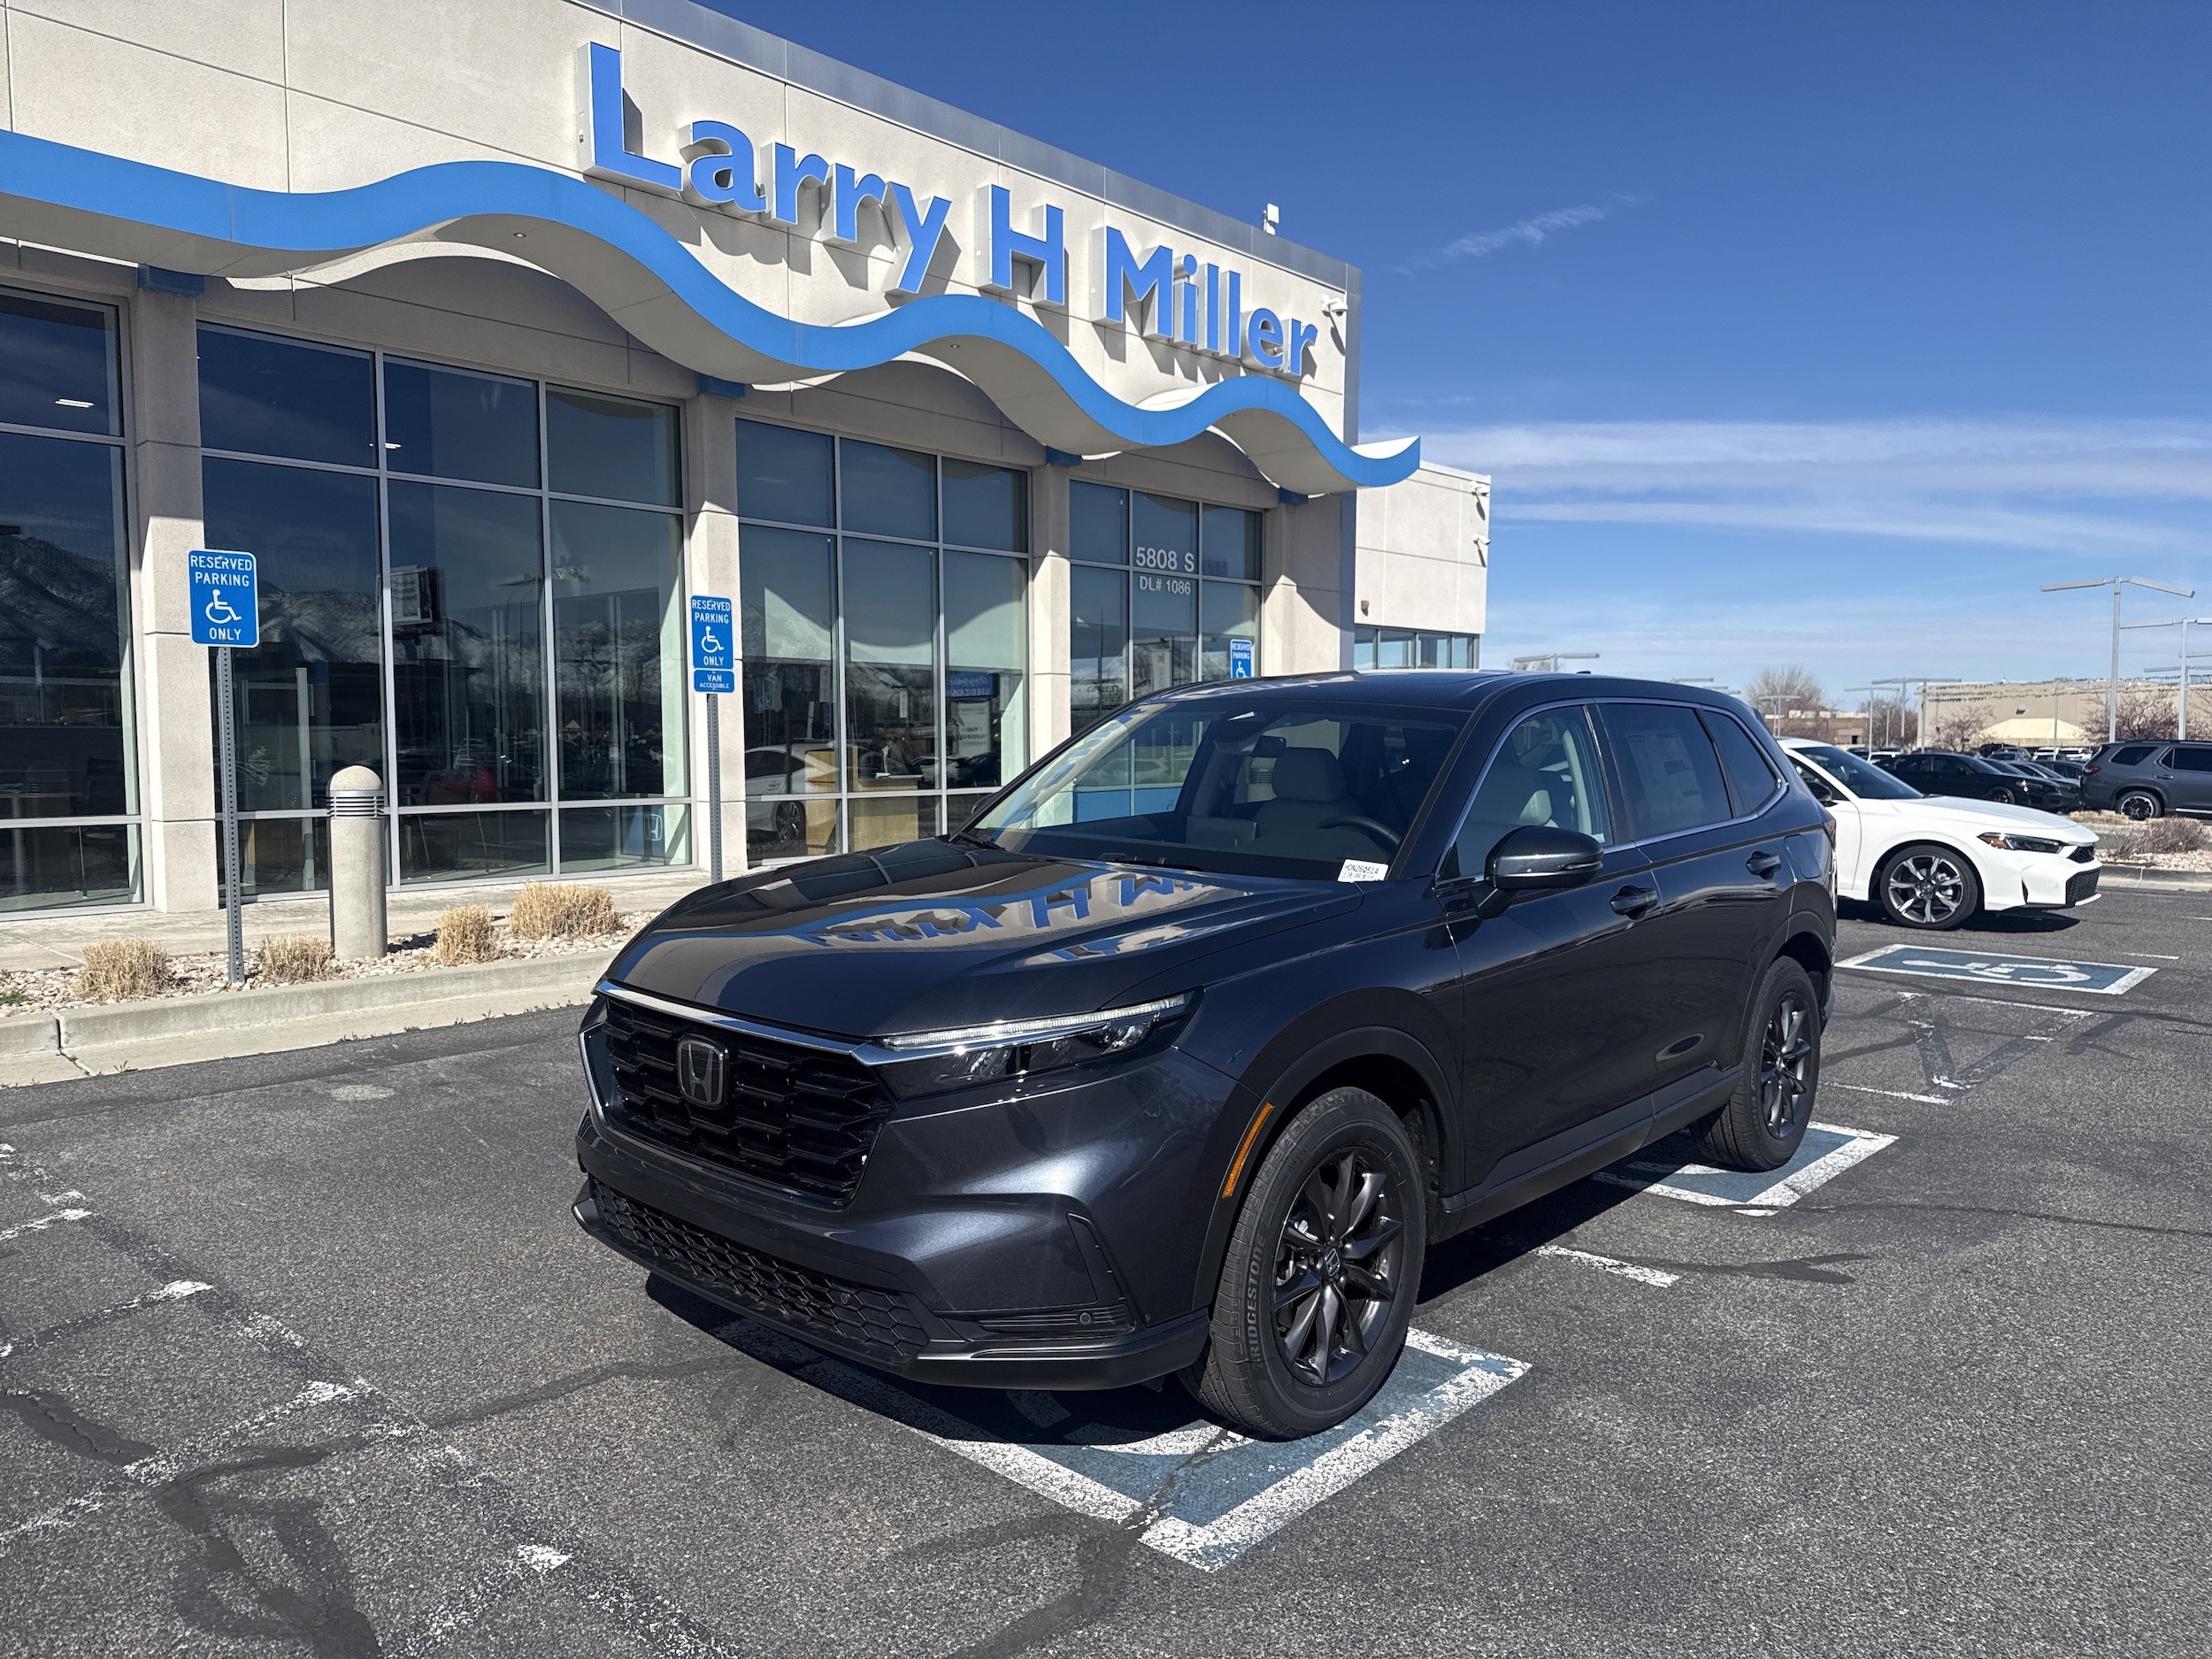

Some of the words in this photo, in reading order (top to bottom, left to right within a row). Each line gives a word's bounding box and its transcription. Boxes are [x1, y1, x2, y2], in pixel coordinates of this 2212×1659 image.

[577, 41, 951, 295] Larry
[978, 184, 1064, 305] H
[1092, 226, 1317, 376] Miller
[190, 555, 252, 571] RESERVED
[1136, 547, 1178, 571] 5808
[1184, 552, 1194, 572] S
[195, 572, 250, 587] PARKING
[1140, 576, 1162, 591] DL#
[1166, 580, 1191, 595] 1086
[691, 599, 731, 611] RESERVED
[695, 612, 729, 625] PARKING
[209, 627, 242, 641] ONLY
[703, 656, 724, 666] ONLY
